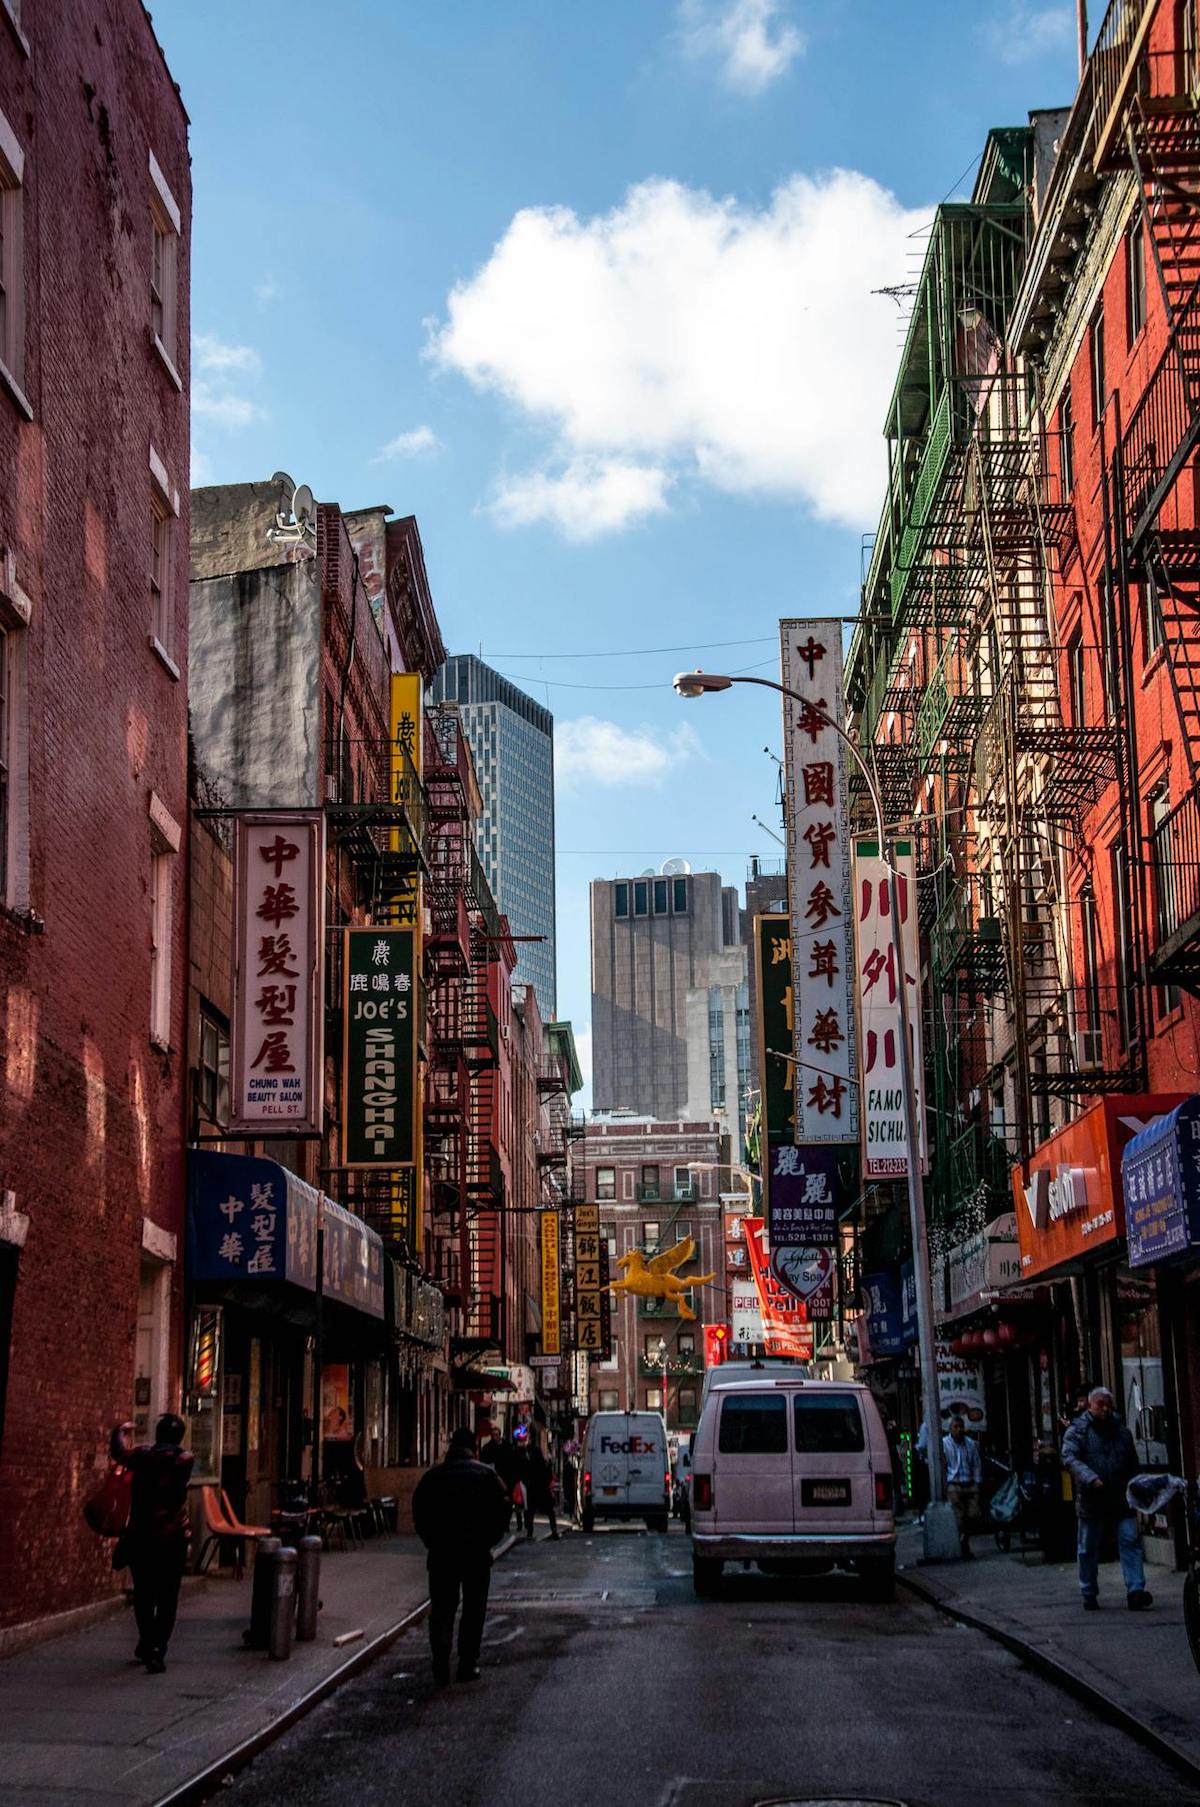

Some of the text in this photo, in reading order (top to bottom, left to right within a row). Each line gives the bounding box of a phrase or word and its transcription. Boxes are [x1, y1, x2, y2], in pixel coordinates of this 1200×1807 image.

[249, 835, 300, 1073] 中華髮型屋
[350, 972, 411, 992] 鹿鳴春
[354, 998, 408, 1020] JOE'S
[249, 1079, 301, 1089] CHUNG WAH
[362, 1027, 398, 1156] SHANGHAI
[247, 1092, 303, 1102] BEAUTY SALON
[262, 1105, 283, 1114] PELL
[868, 1119, 922, 1143] SICHU
[808, 1298, 831, 1308] FOOT
[811, 1307, 828, 1318] RUB
[600, 1436, 656, 1454] FedEx
